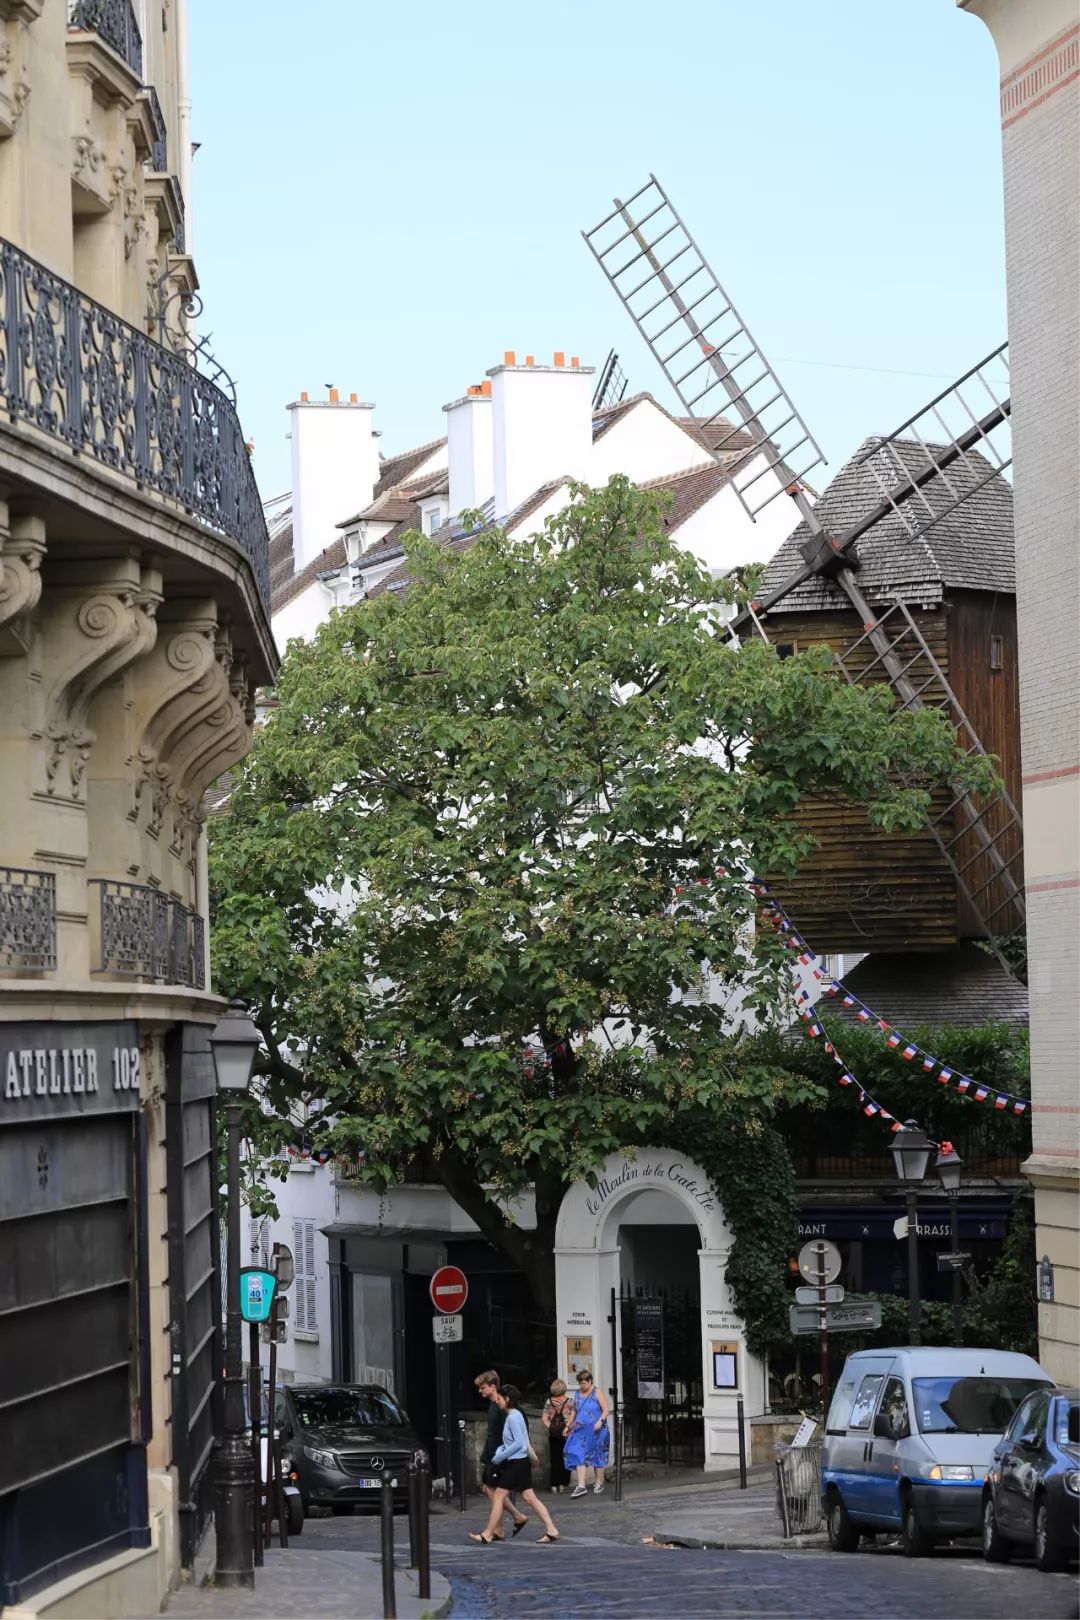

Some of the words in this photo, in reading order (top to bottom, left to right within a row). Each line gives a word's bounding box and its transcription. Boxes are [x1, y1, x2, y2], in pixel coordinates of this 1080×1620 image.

[5, 1049, 99, 1098] ATELIER
[113, 1047, 140, 1090] 102
[586, 1198, 600, 1215] le
[595, 1162, 638, 1202] Moulin
[642, 1164, 652, 1176] de
[668, 1163, 715, 1213] Galette
[798, 1224, 827, 1234] RANT
[441, 1317, 456, 1325] SAUF
